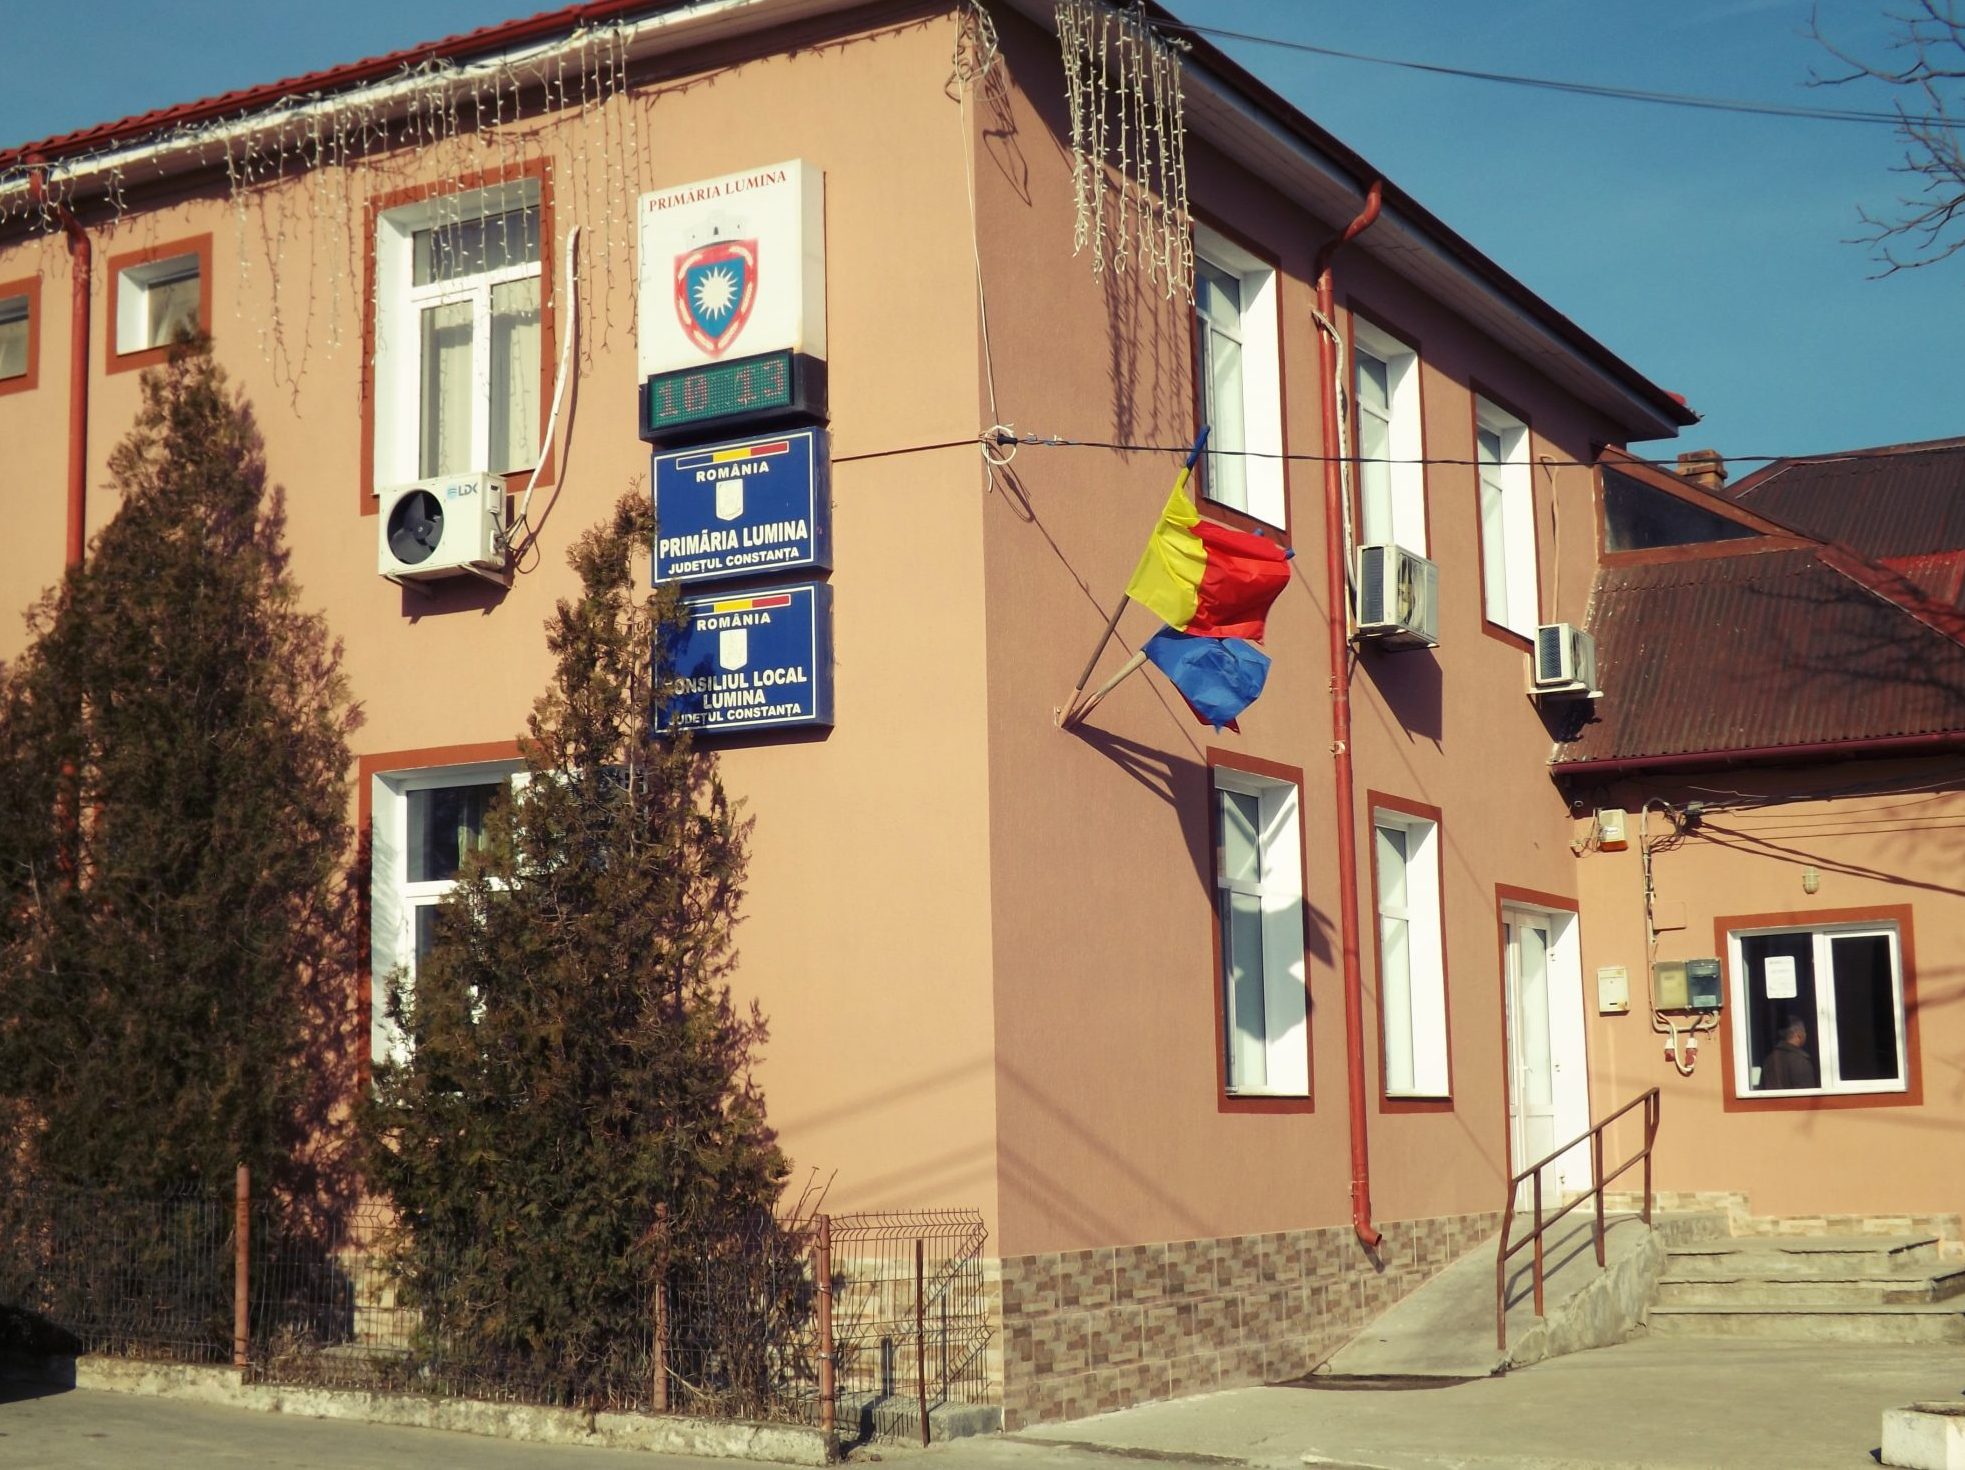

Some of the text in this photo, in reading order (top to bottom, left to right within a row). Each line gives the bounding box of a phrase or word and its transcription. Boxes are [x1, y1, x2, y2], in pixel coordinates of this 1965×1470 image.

[725, 169, 787, 195] LUMINA
[696, 461, 769, 482] ROMÂNIA
[743, 519, 808, 547] LUMINA
[696, 612, 771, 631] ROMÂNIA
[664, 666, 807, 695] ONSILIUL LOCAL
[703, 689, 766, 710] LUMINA
